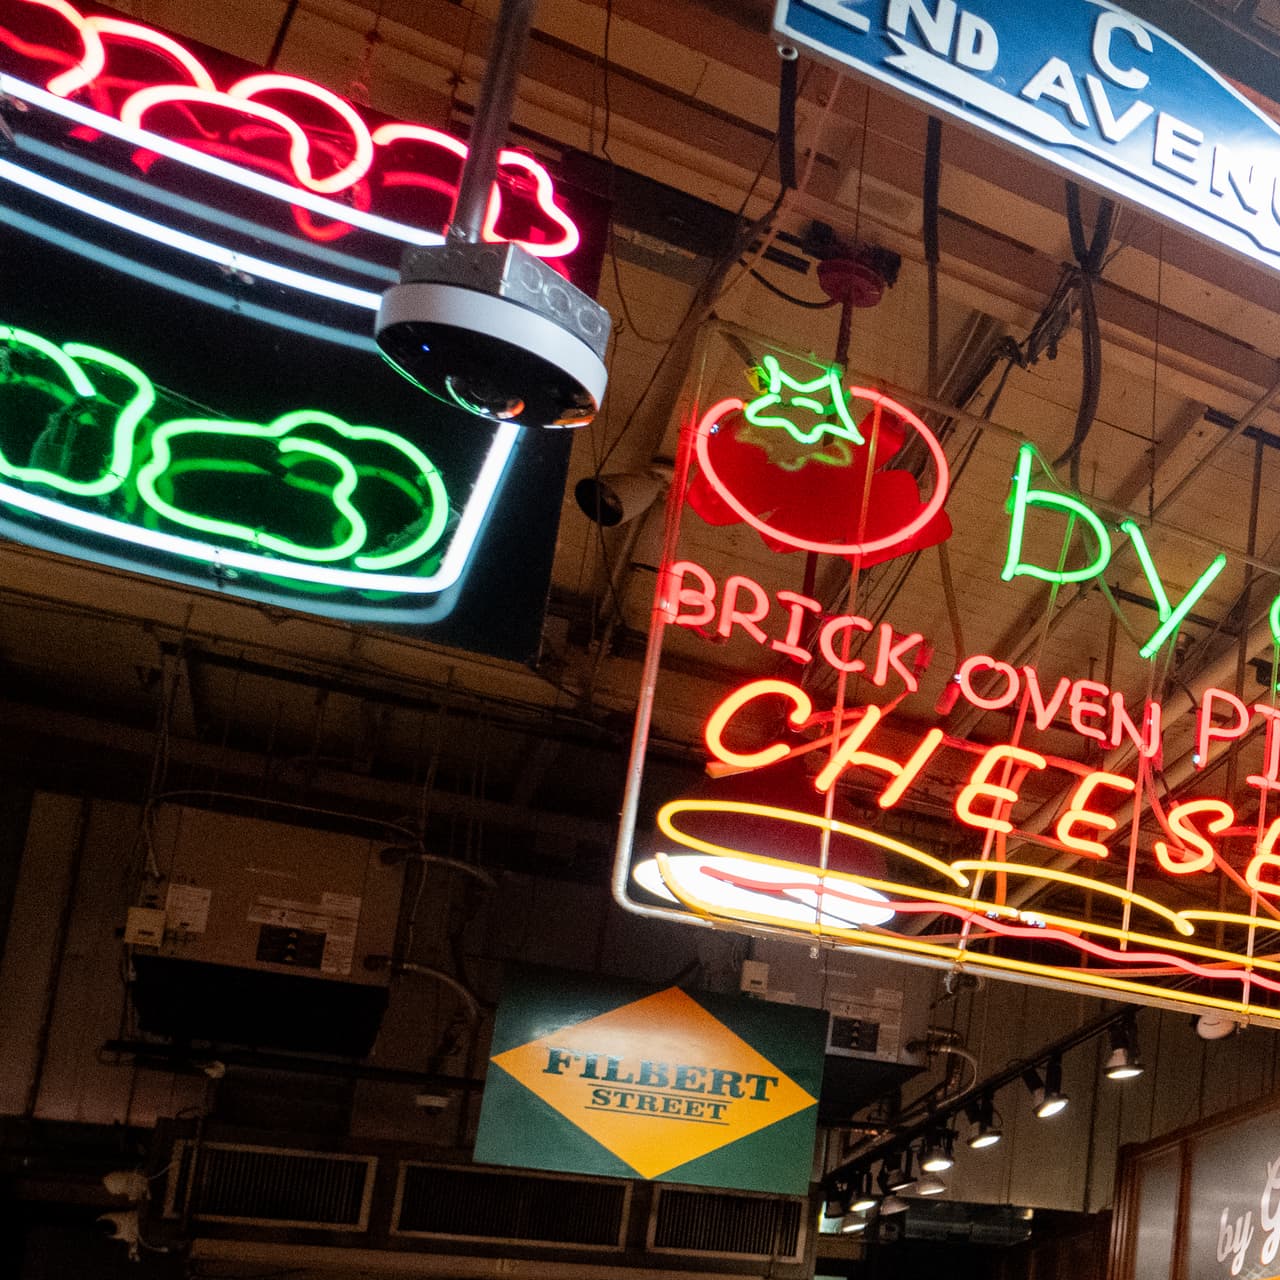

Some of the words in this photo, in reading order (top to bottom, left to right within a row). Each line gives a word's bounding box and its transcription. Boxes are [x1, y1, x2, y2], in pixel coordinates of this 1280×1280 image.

[1092, 6, 1154, 89] C
[1000, 441, 1226, 659] by
[664, 559, 924, 691] BRICK
[956, 653, 1162, 758] OVEN
[542, 1044, 780, 1102] FILBERT
[591, 1086, 729, 1121] STREET
[1216, 1205, 1254, 1276] by
